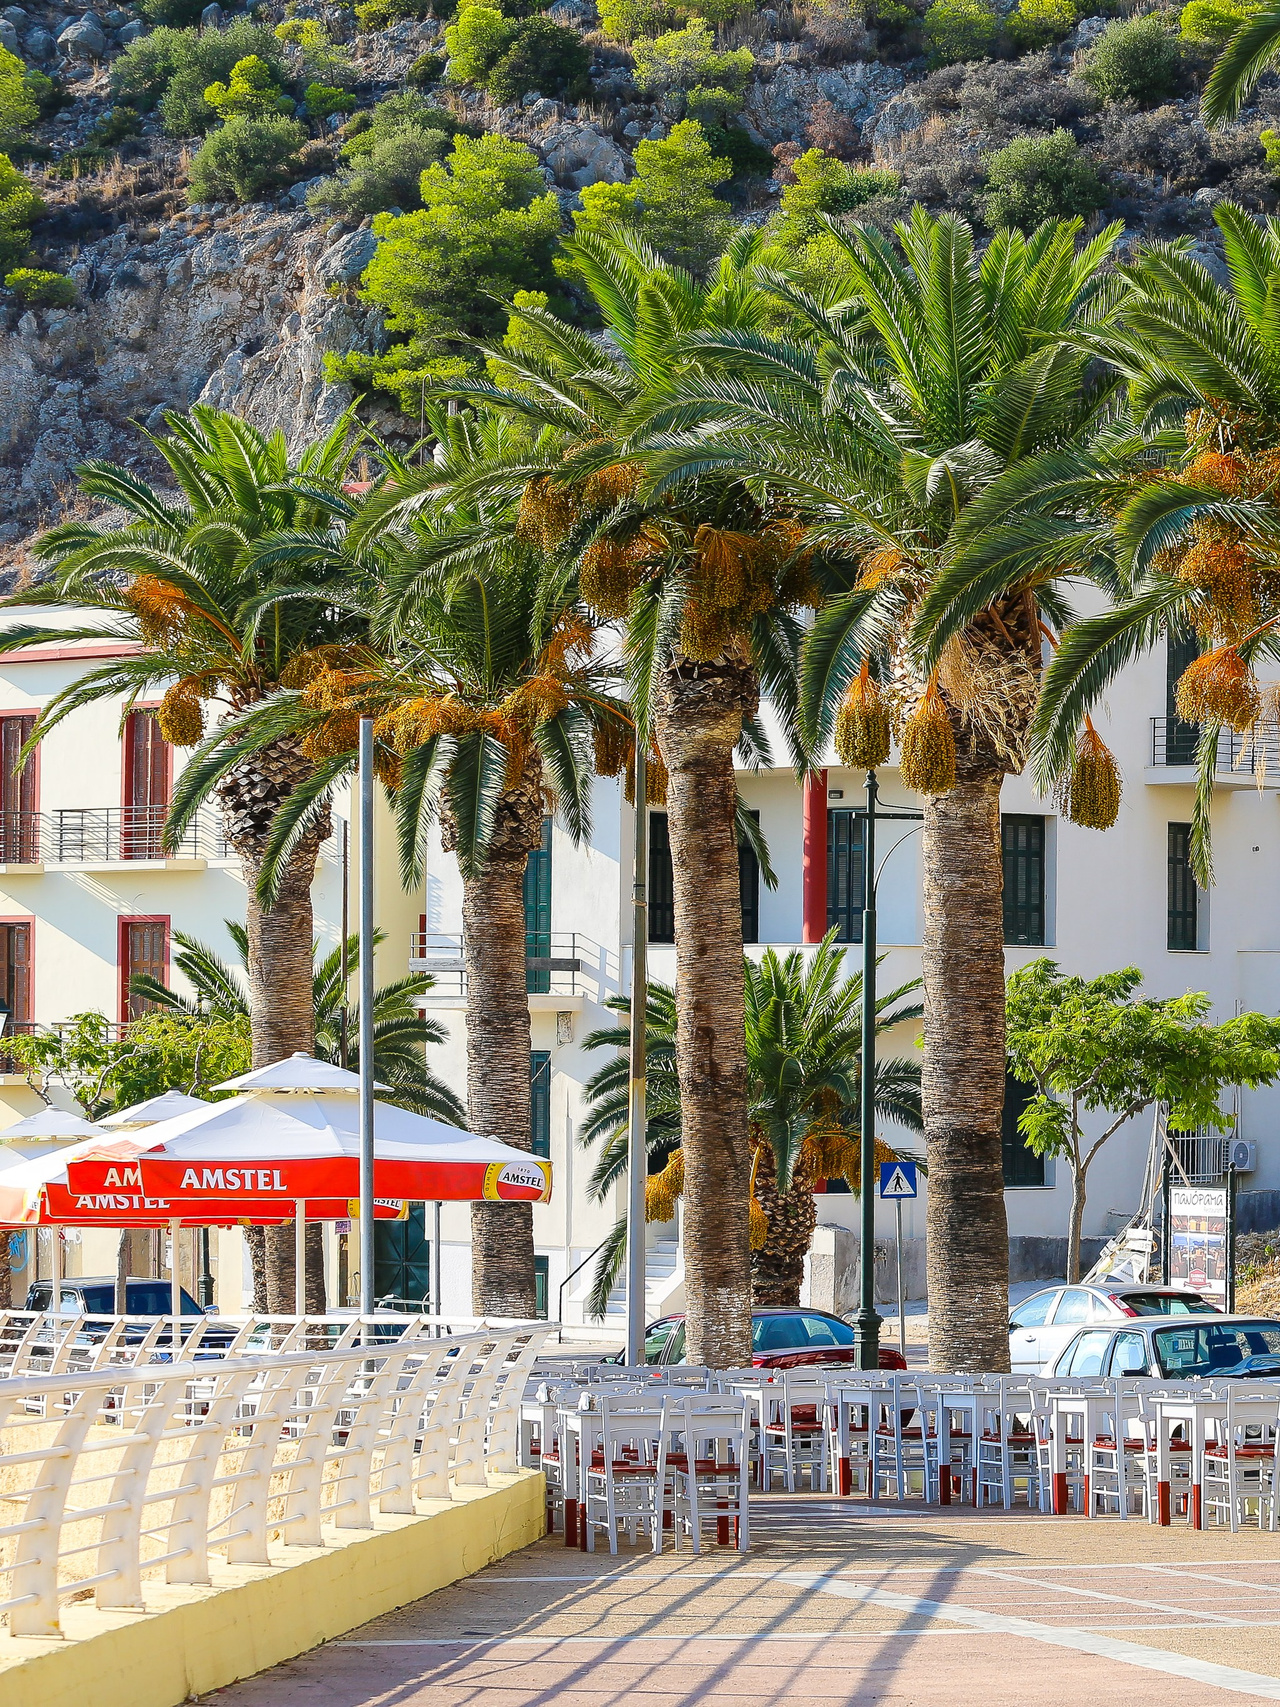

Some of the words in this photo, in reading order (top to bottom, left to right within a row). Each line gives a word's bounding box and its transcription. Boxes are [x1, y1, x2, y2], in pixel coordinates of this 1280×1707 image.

[517, 1166, 531, 1174] 1870
[180, 1168, 288, 1191] AMSTEL
[503, 1172, 542, 1188] AMSTEL
